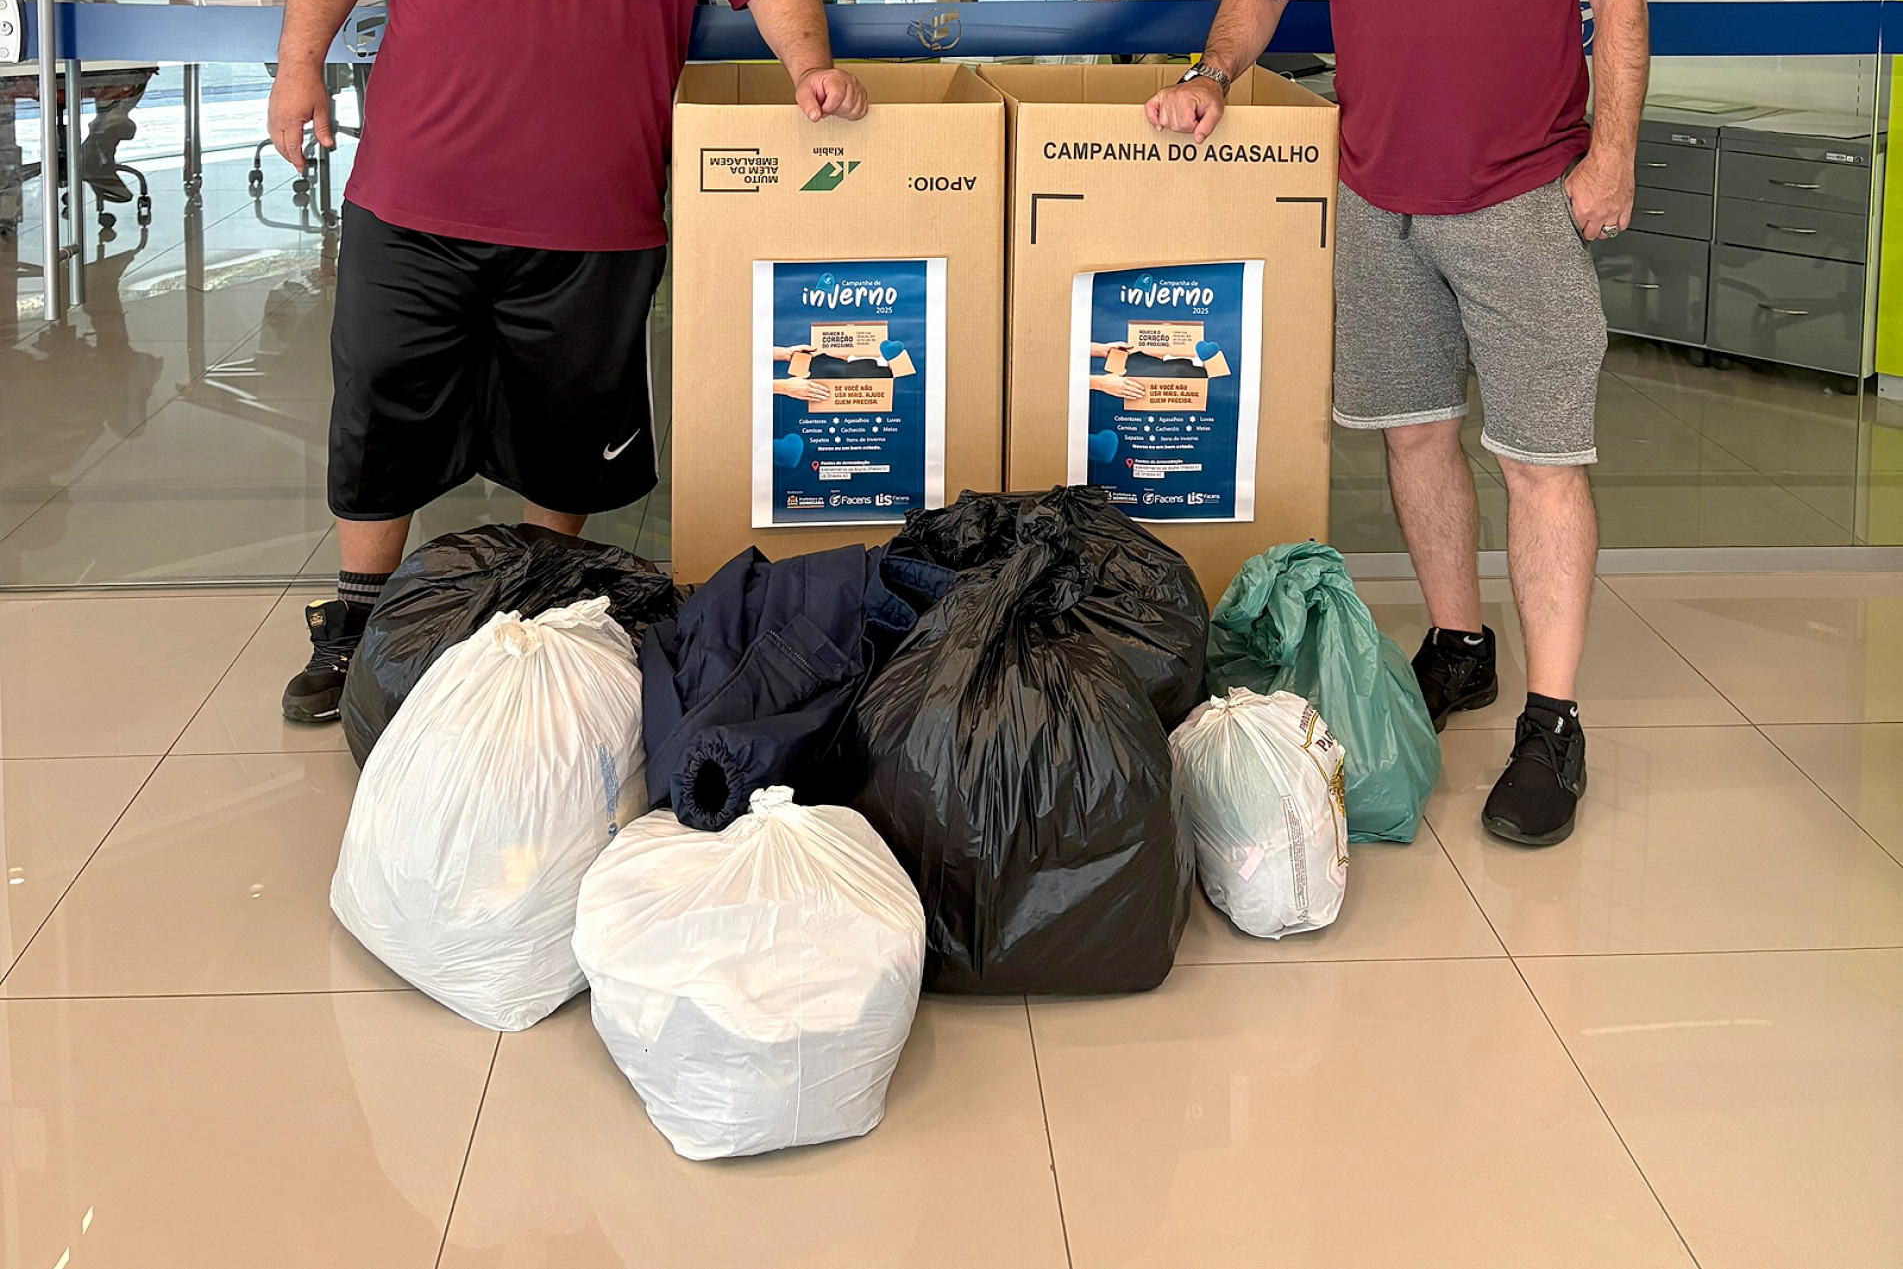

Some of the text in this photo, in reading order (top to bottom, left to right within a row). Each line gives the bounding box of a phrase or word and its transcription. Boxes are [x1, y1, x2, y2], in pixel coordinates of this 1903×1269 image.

[813, 147, 844, 157] Klabin
[1043, 142, 1319, 163] CAMPANHA DO AGASALHO
[710, 157, 778, 166] EMBALAGEM
[730, 166, 778, 176] ALÉM DA
[744, 175, 778, 184] MUITO
[908, 176, 977, 192] APOIO:
[802, 283, 898, 309] inverno
[1120, 282, 1214, 308] inverno
[1192, 307, 1209, 315] 2025
[842, 495, 872, 505] Facens
[1154, 493, 1184, 503] Facens
